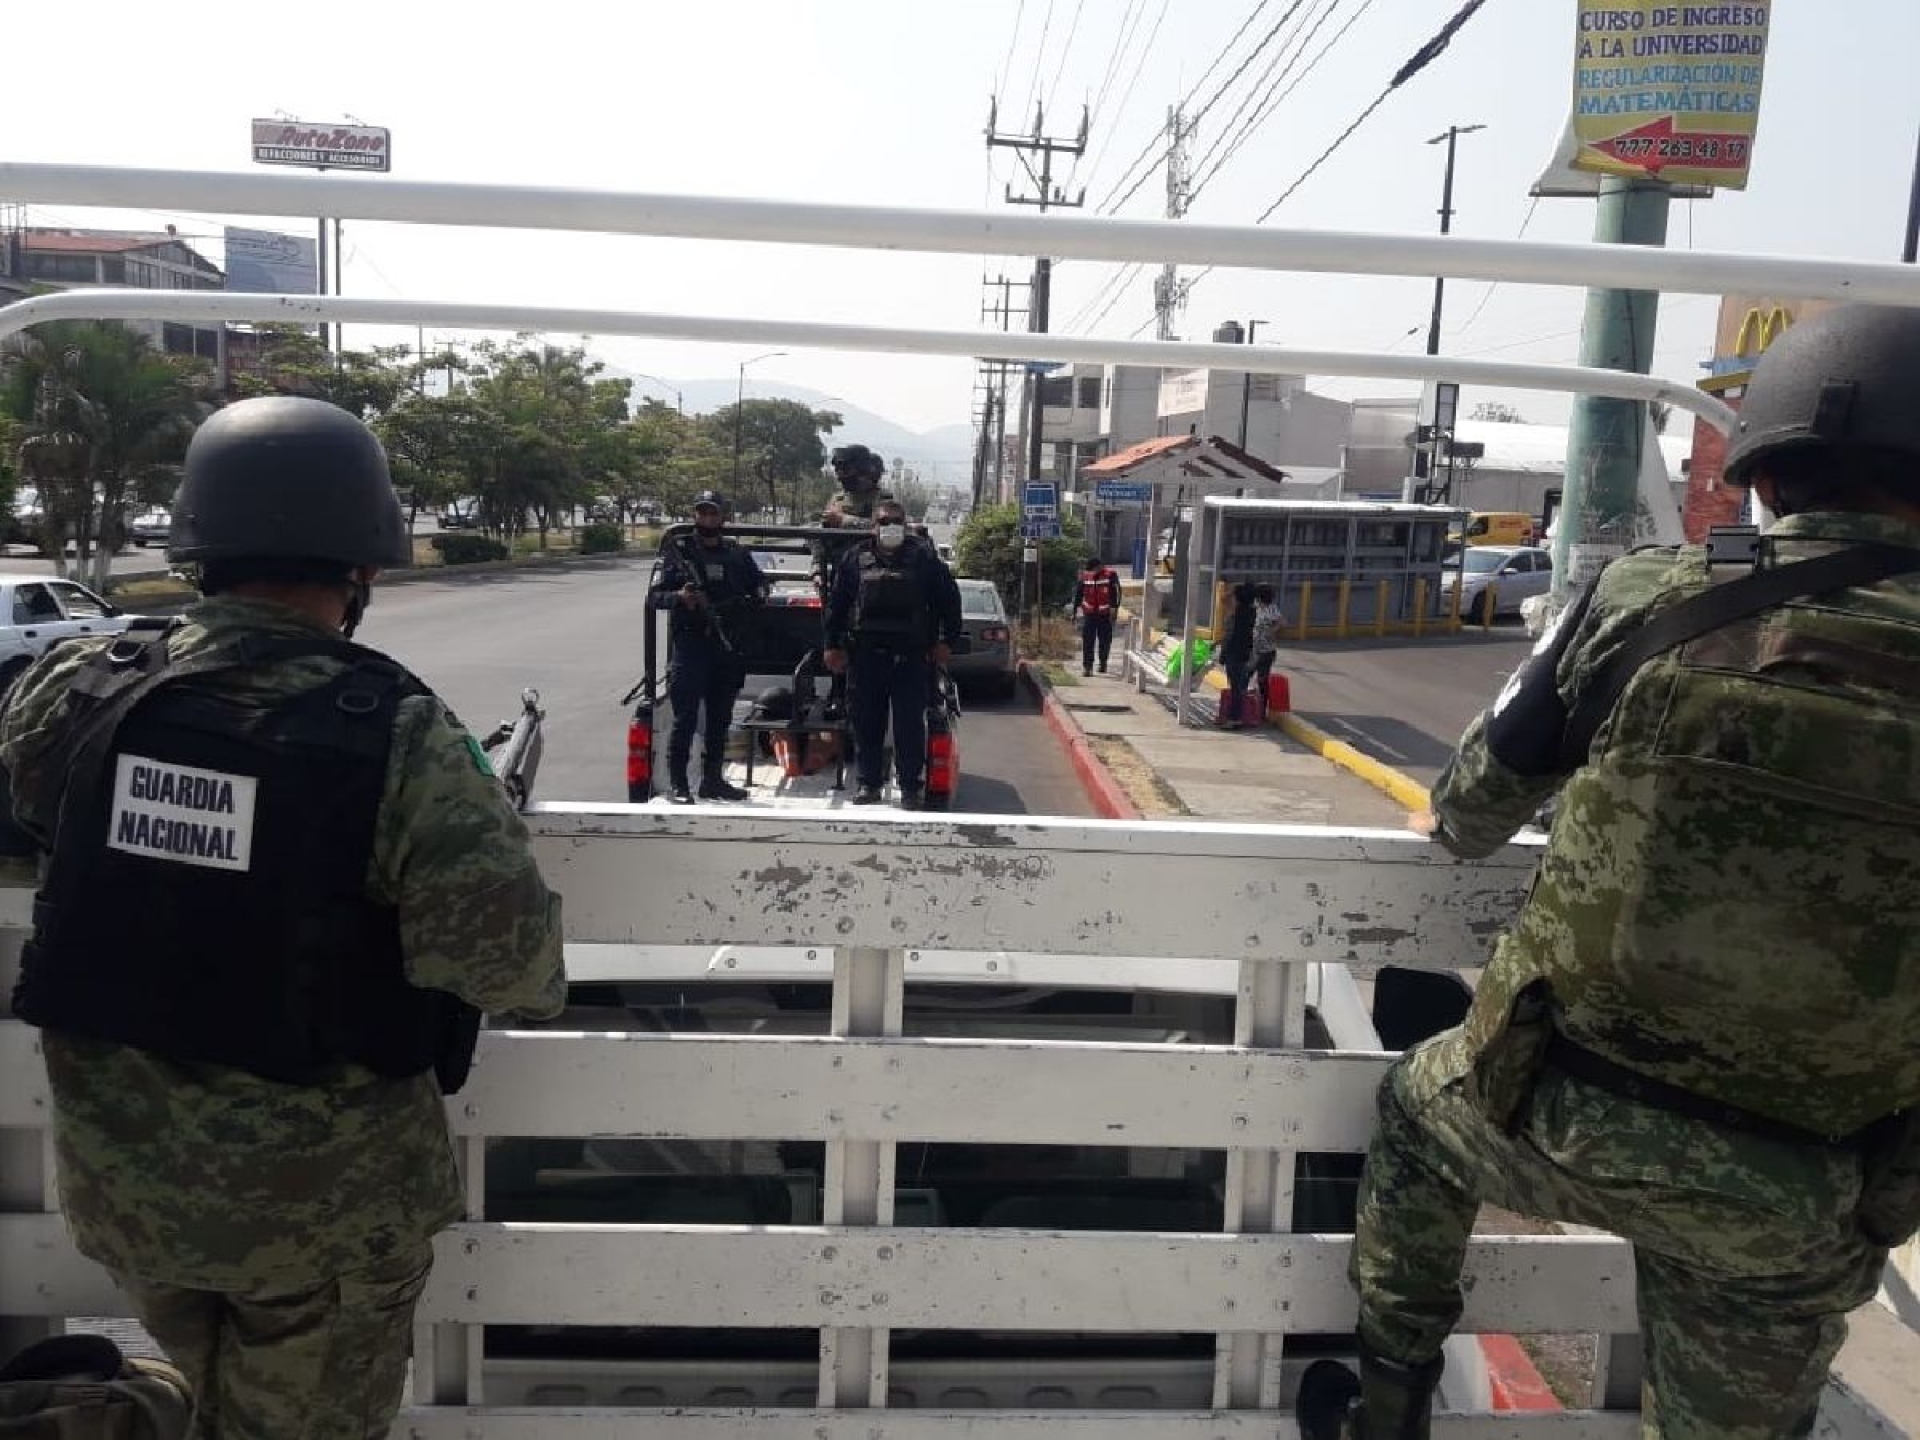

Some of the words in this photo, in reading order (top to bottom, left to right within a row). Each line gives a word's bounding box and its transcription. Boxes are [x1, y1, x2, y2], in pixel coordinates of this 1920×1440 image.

[1579, 10, 1645, 32] CURSO
[1652, 8, 1678, 28] DE
[1682, 7, 1765, 27] INGRESO
[1578, 40, 1593, 59] A
[1600, 37, 1625, 58] LA
[1632, 33, 1763, 57] UNIVERSIDAD
[1579, 63, 1736, 88] REGULARIZACIÓN
[1740, 64, 1760, 85] DE
[1579, 86, 1756, 114] MATEMÁTICAS
[1615, 138, 1653, 156] 777
[131, 766, 235, 813] GUARDIA
[118, 810, 239, 861] NACIONAL
